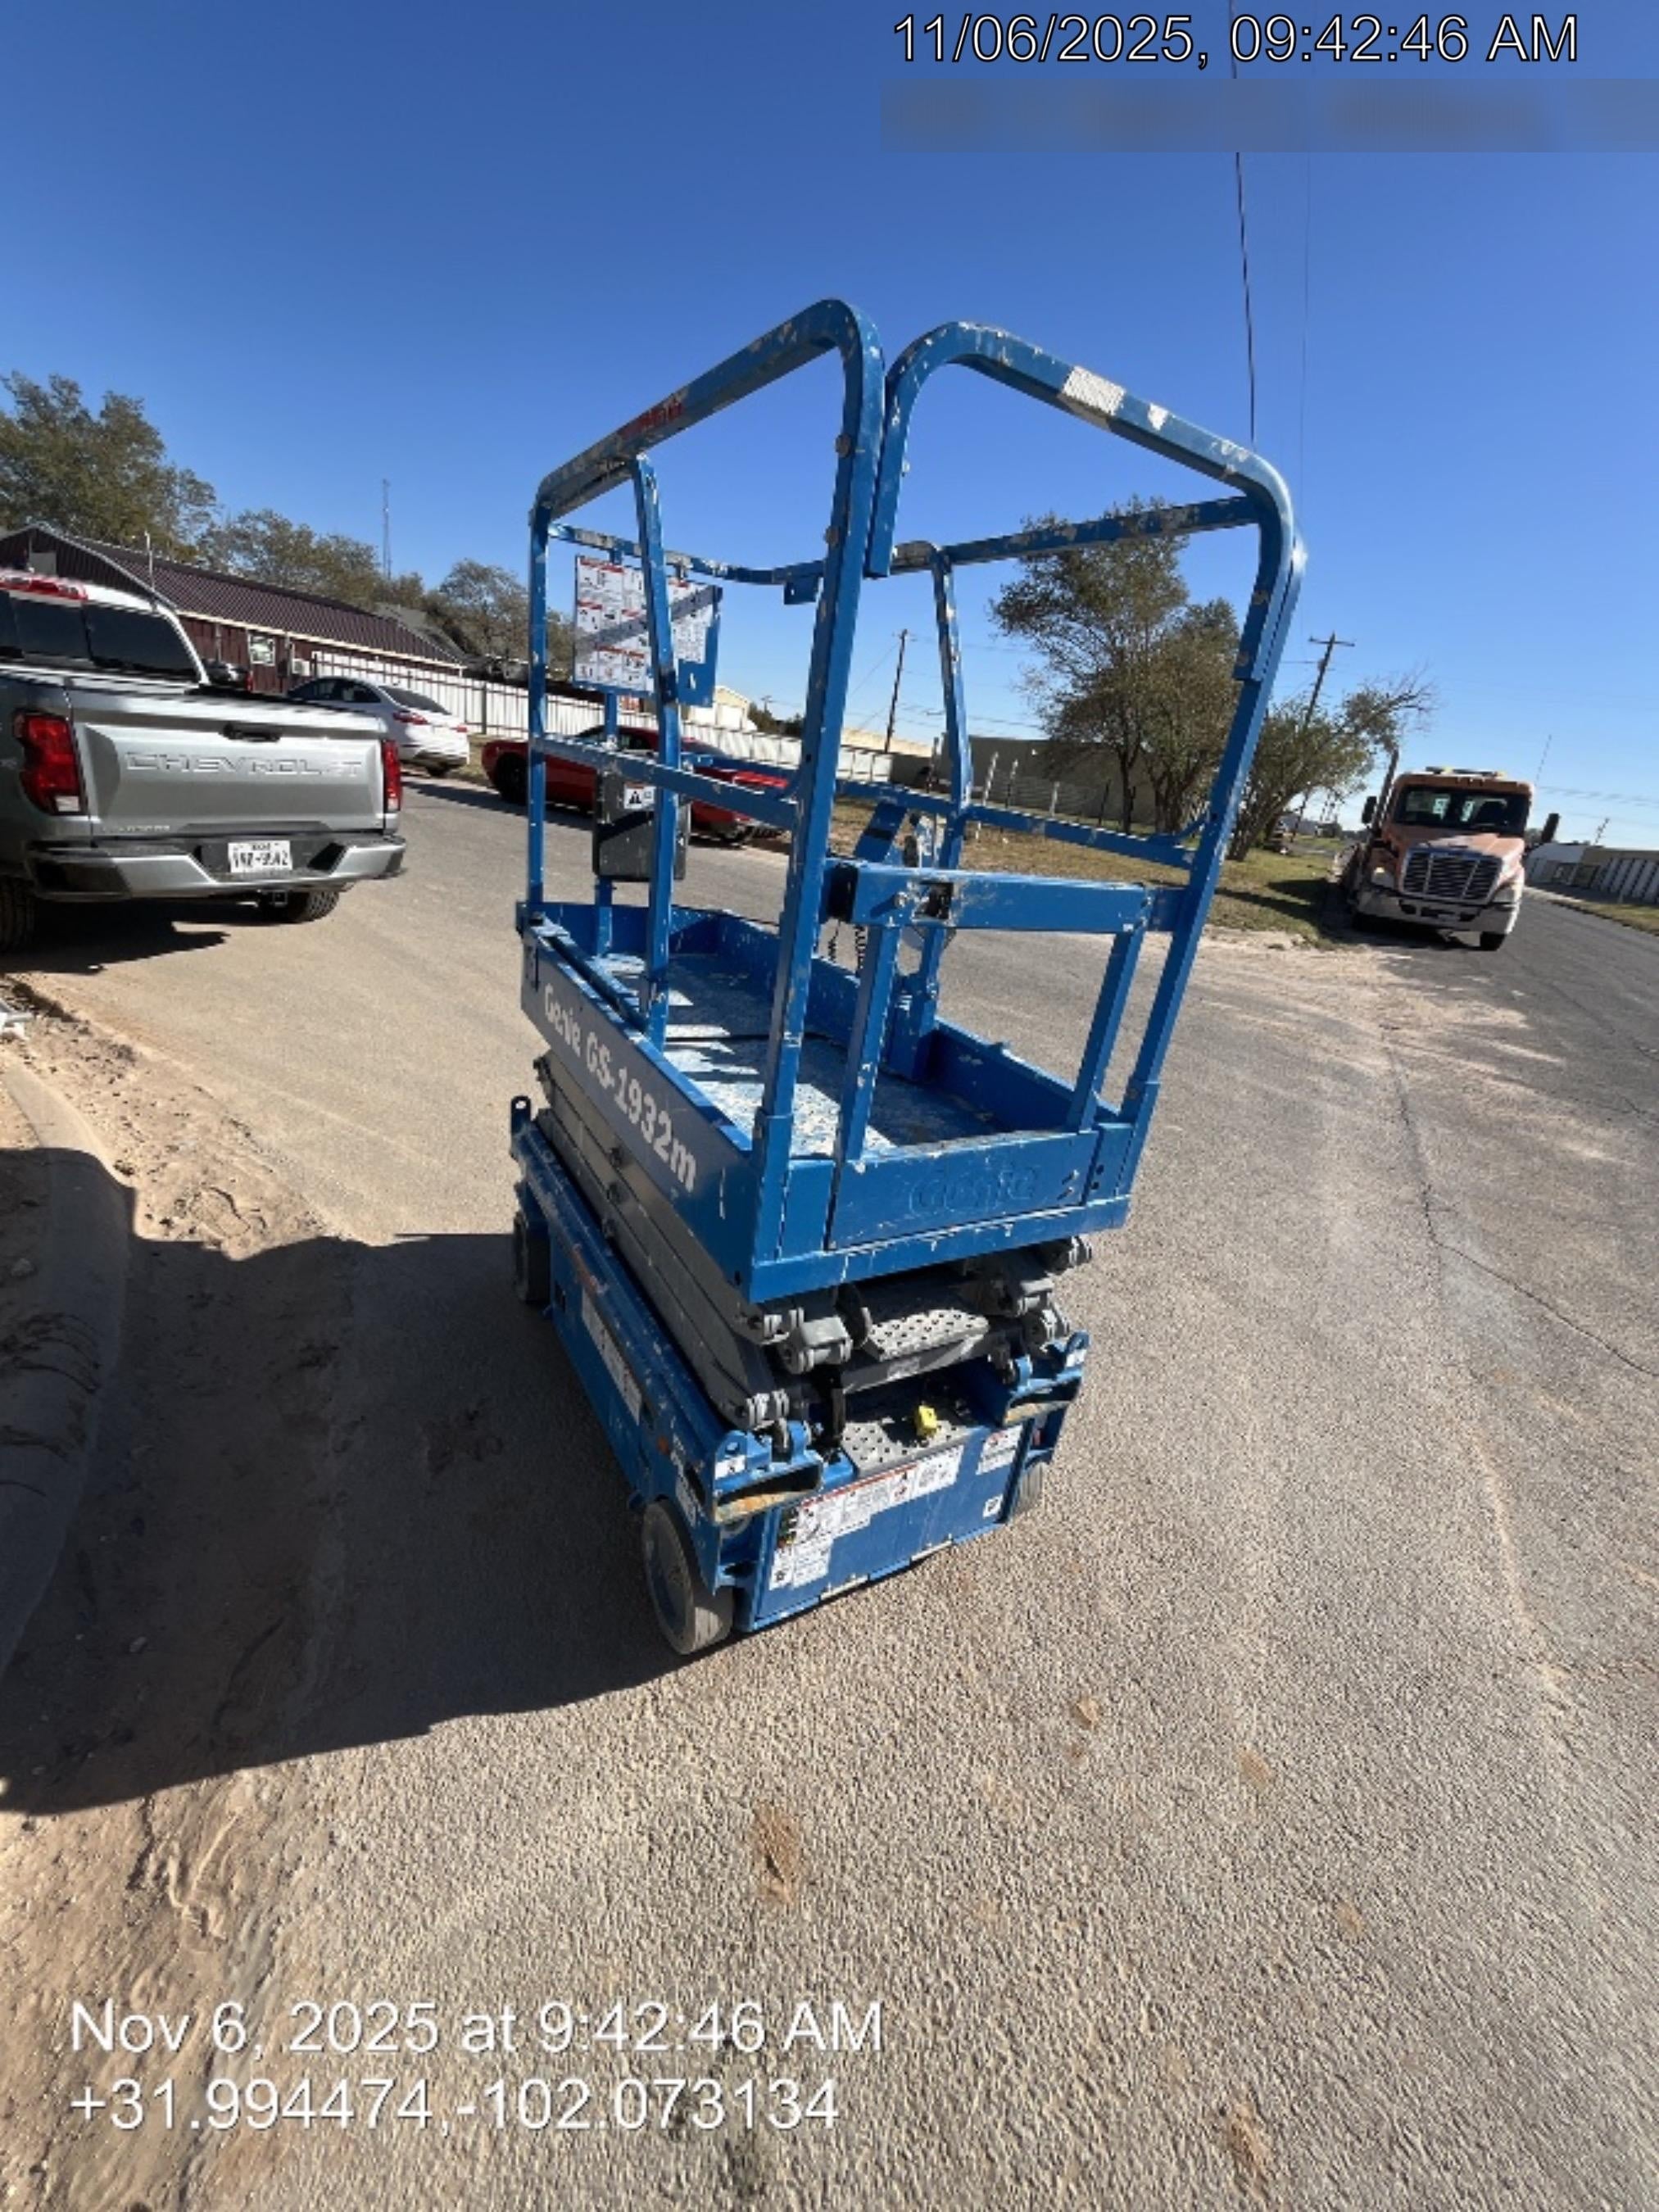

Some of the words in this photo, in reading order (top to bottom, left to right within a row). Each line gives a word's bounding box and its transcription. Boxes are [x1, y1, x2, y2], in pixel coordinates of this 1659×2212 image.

[125, 750, 362, 777] CHEVROLET
[545, 983, 581, 1058] Genie
[586, 1031, 696, 1193] GS-1932m
